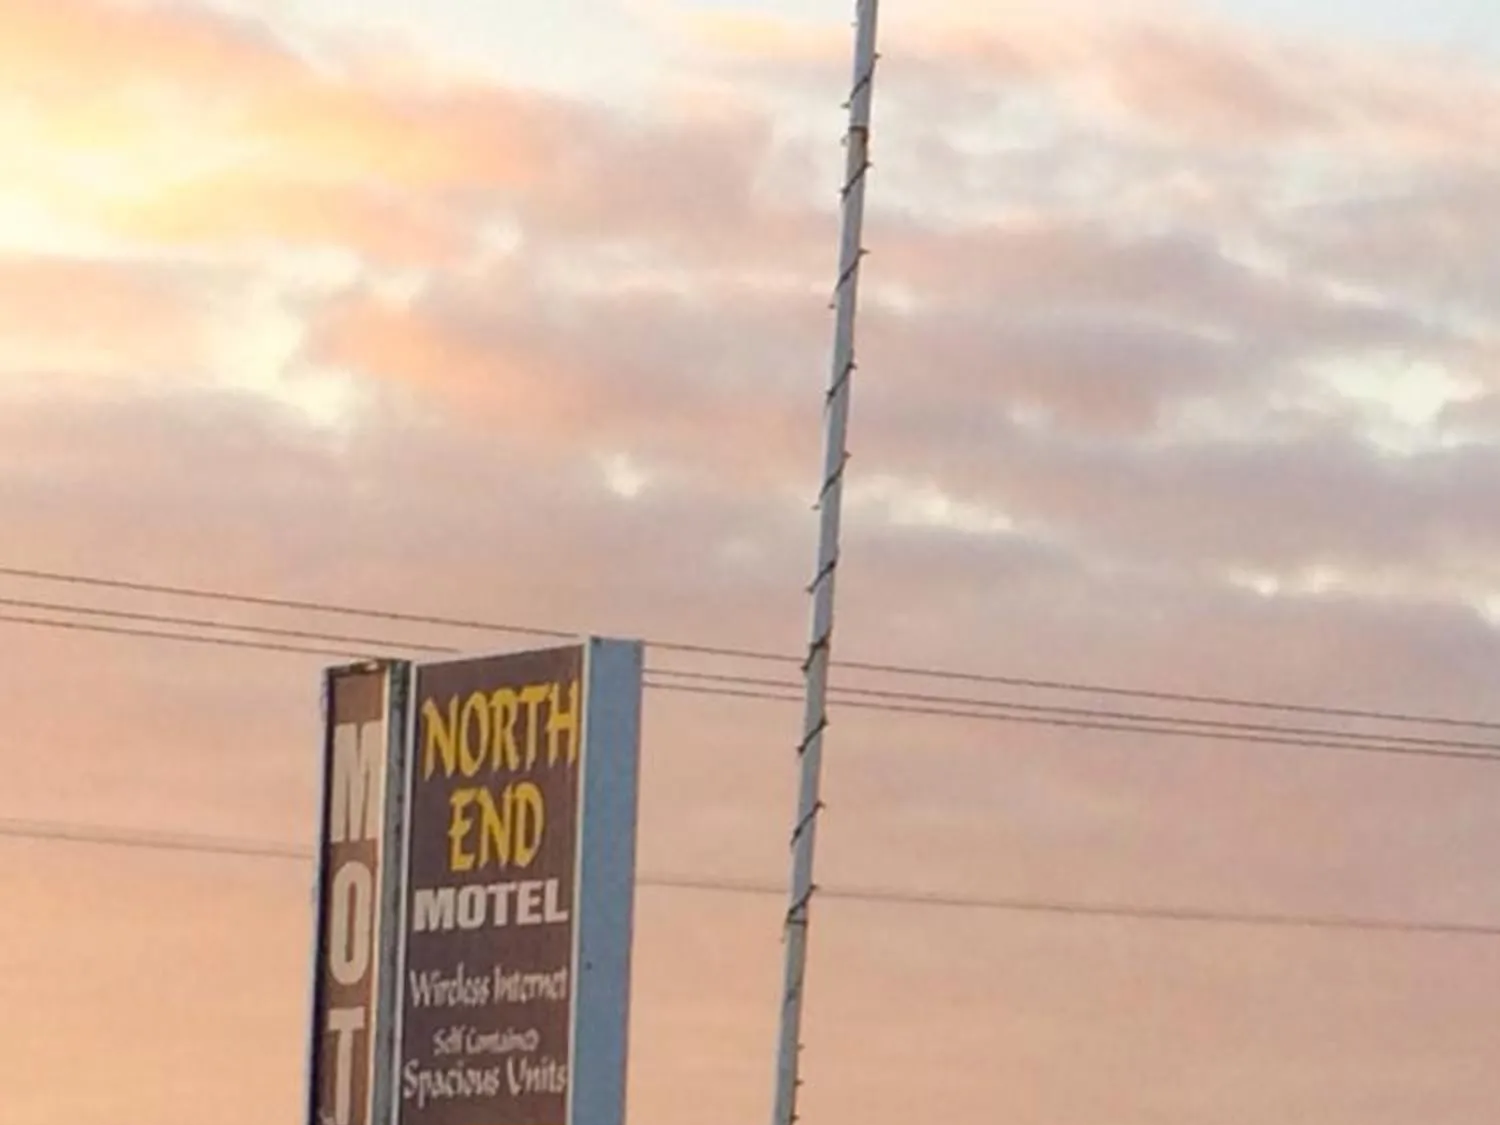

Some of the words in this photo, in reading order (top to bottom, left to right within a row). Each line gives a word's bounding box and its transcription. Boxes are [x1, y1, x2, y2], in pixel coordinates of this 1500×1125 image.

[421, 680, 579, 781] NORTH
[448, 782, 545, 872] END
[413, 879, 569, 931] MOTEL
[409, 961, 491, 1007] Wireless
[494, 965, 568, 1002] Internet
[433, 1024, 465, 1055] Self
[403, 1058, 500, 1109] Spacious
[507, 1055, 568, 1096] Units
